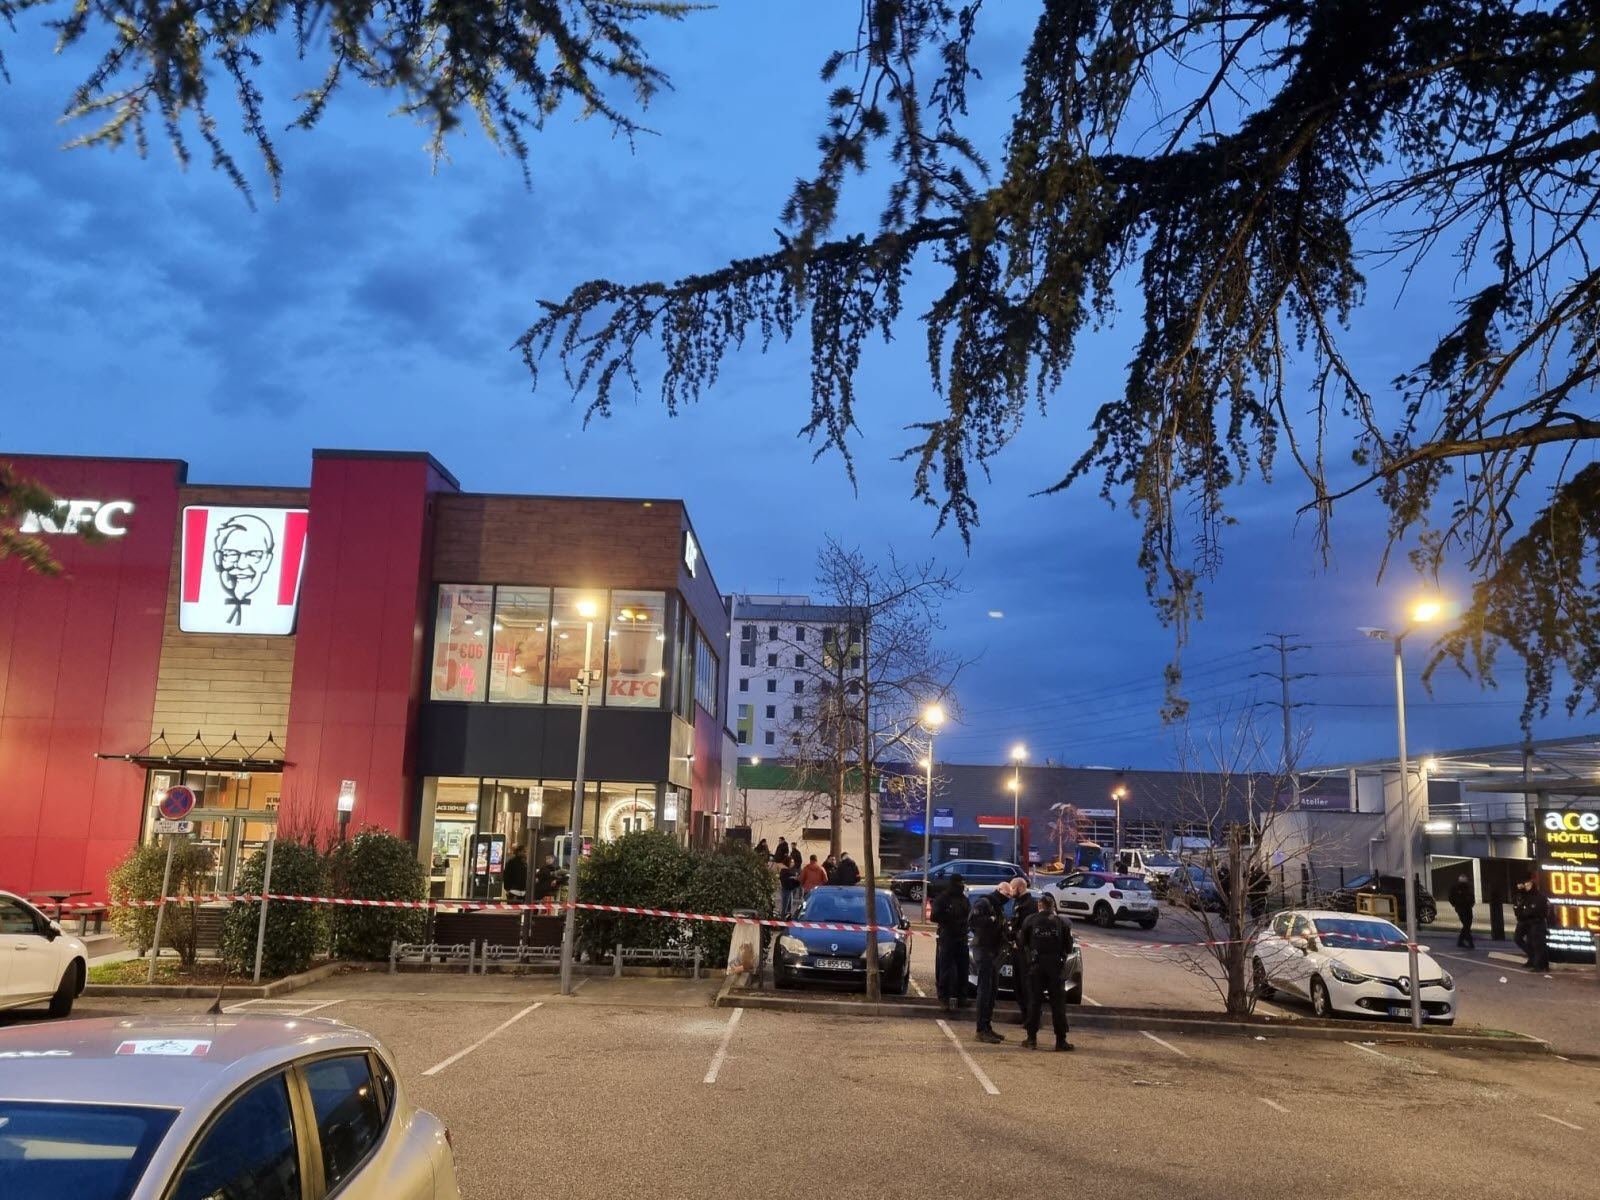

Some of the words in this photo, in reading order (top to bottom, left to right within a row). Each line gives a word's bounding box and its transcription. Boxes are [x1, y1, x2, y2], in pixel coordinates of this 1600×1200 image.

[608, 679, 658, 698] KFC
[1301, 798, 1329, 806] Atelier
[1545, 812, 1599, 831] ace
[1547, 831, 1599, 844] HÔTEL
[1551, 872, 1600, 896] 069
